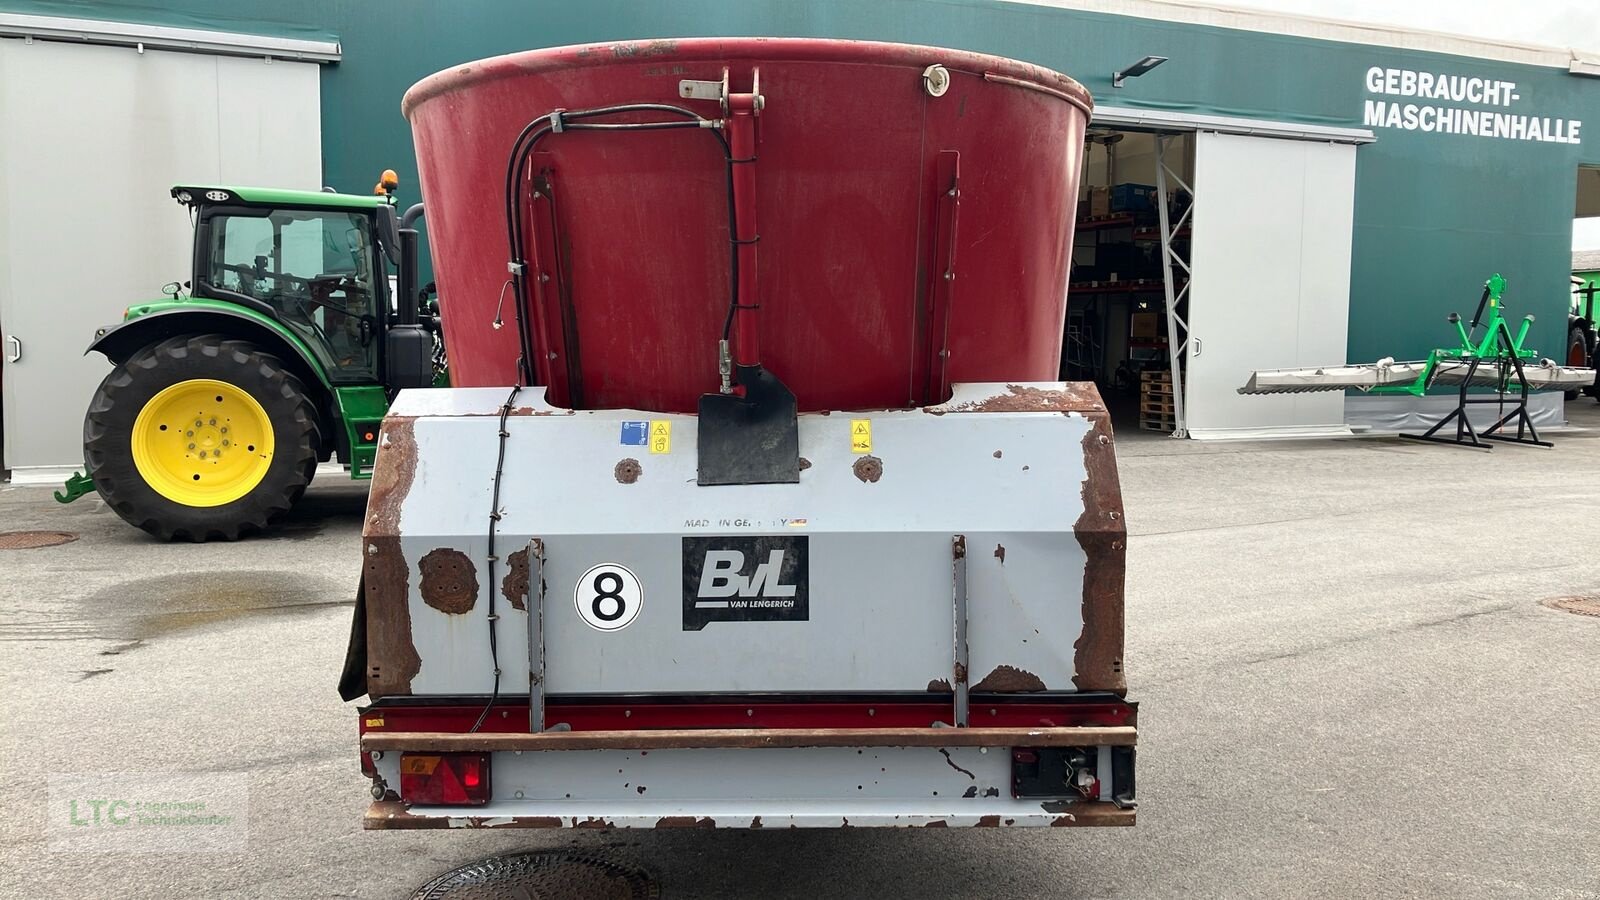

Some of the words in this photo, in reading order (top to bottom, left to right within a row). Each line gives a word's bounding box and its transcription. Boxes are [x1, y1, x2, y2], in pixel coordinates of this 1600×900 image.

[1366, 66, 1520, 107] GEBRAUCHT-
[1364, 100, 1582, 144] MASCHINENHALLE
[592, 572, 626, 621] 8
[730, 600, 748, 608] VAN
[749, 600, 794, 608] LENGERICH
